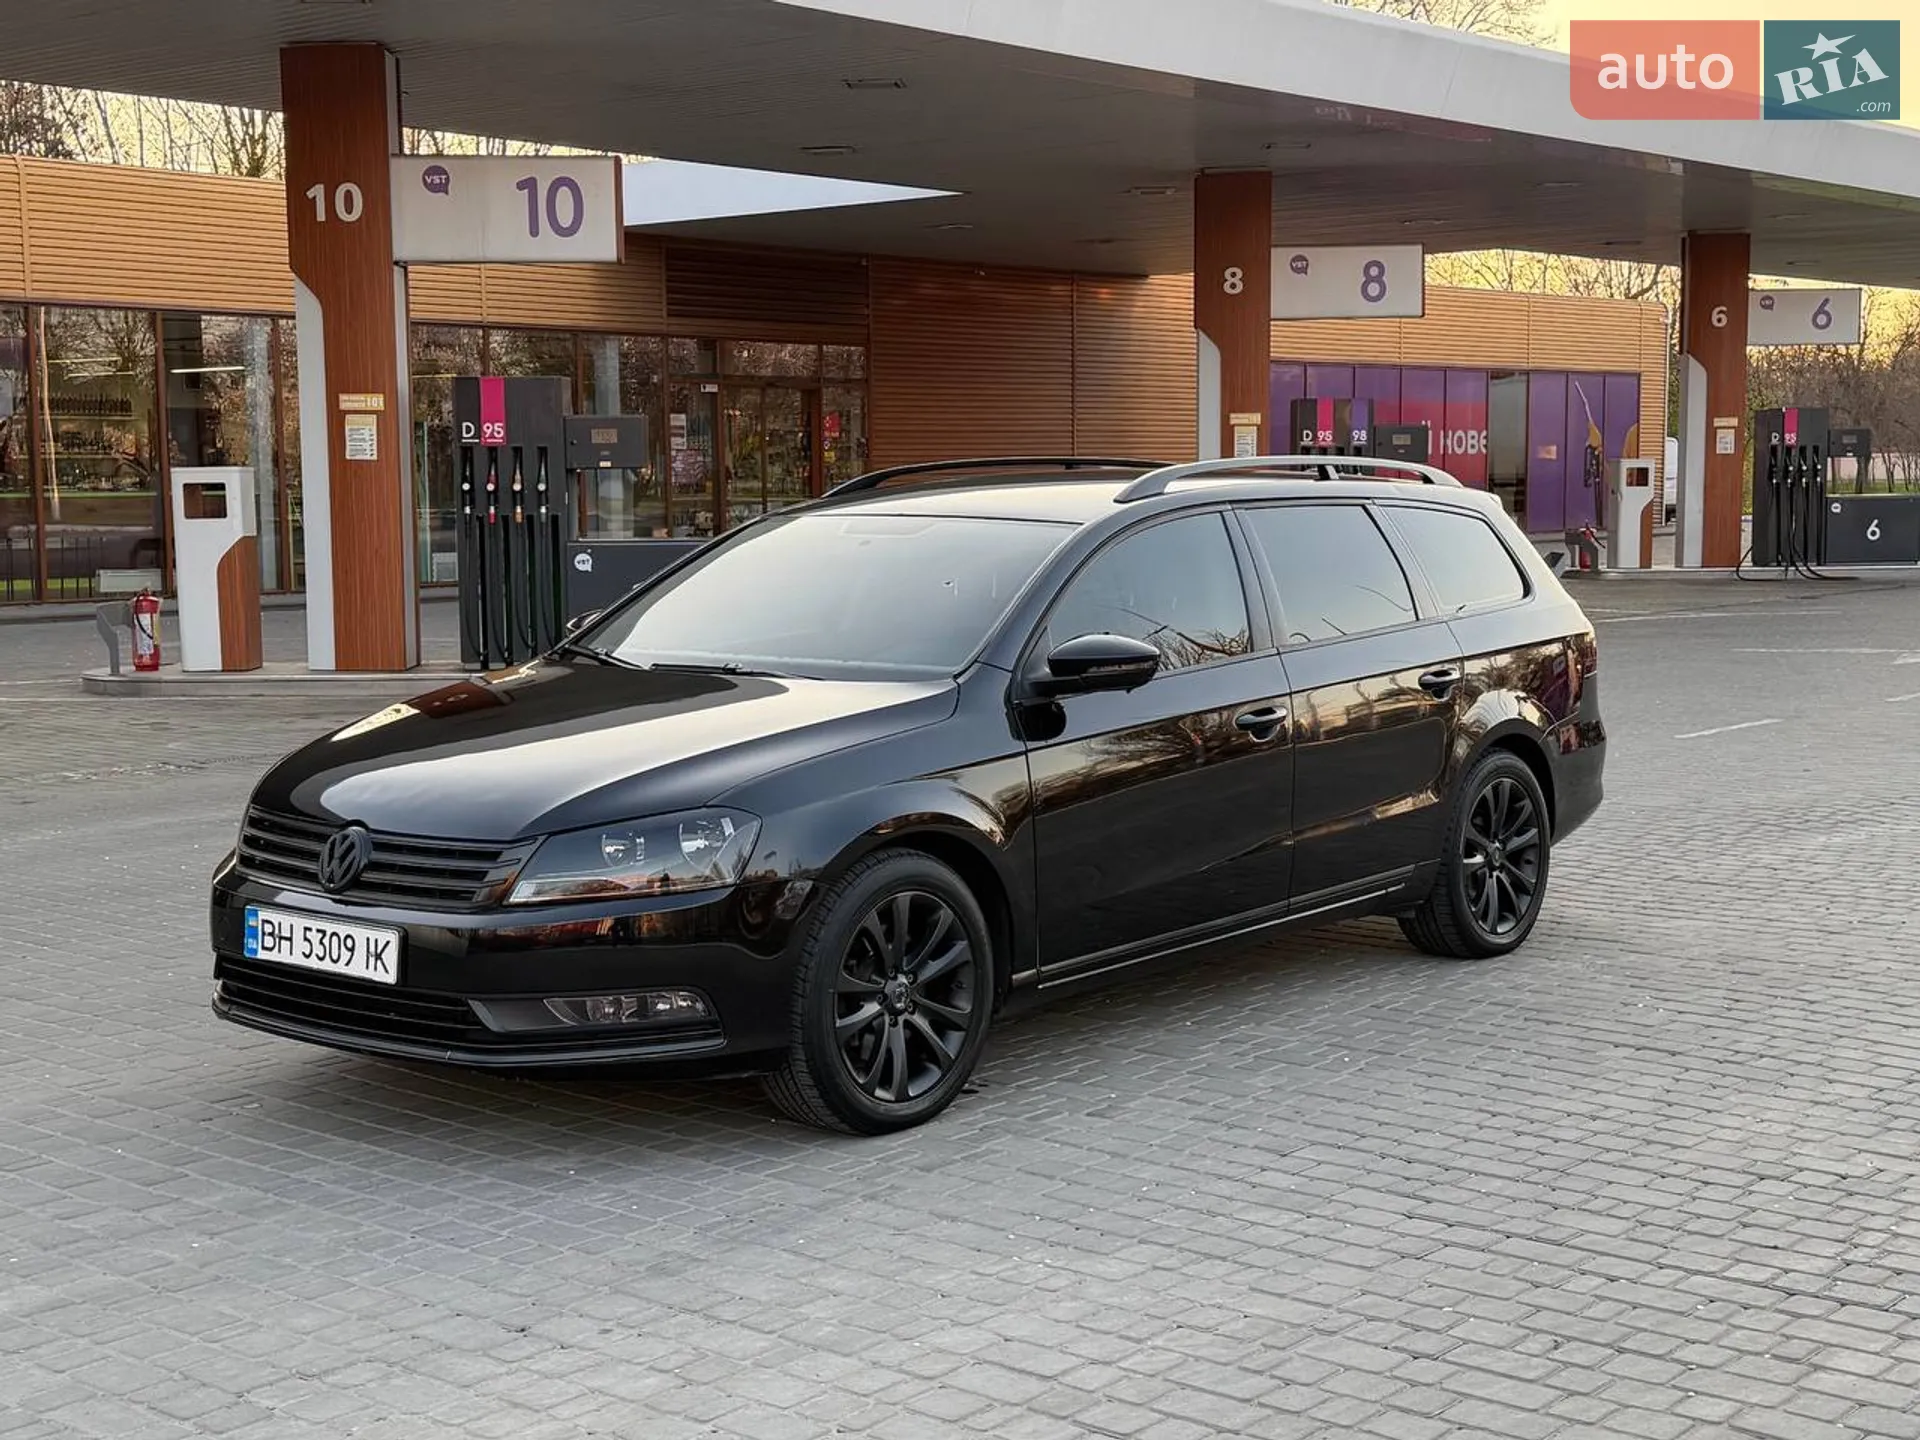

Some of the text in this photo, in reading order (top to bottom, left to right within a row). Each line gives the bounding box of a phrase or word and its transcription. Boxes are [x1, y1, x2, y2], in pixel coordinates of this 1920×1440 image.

[424, 174, 449, 185] VST
[305, 182, 363, 223] 10
[515, 175, 585, 239] 10
[1222, 266, 1244, 295] 8
[1360, 259, 1388, 303] 8
[1710, 305, 1728, 328] 6
[1811, 297, 1833, 330] 6
[461, 421, 476, 438] D
[482, 422, 505, 438] 95
[1302, 429, 1313, 441] D
[1316, 429, 1334, 441] 95
[1352, 429, 1367, 441] 98
[1866, 518, 1882, 541] 6
[261, 918, 391, 975] BH 5309 IK
